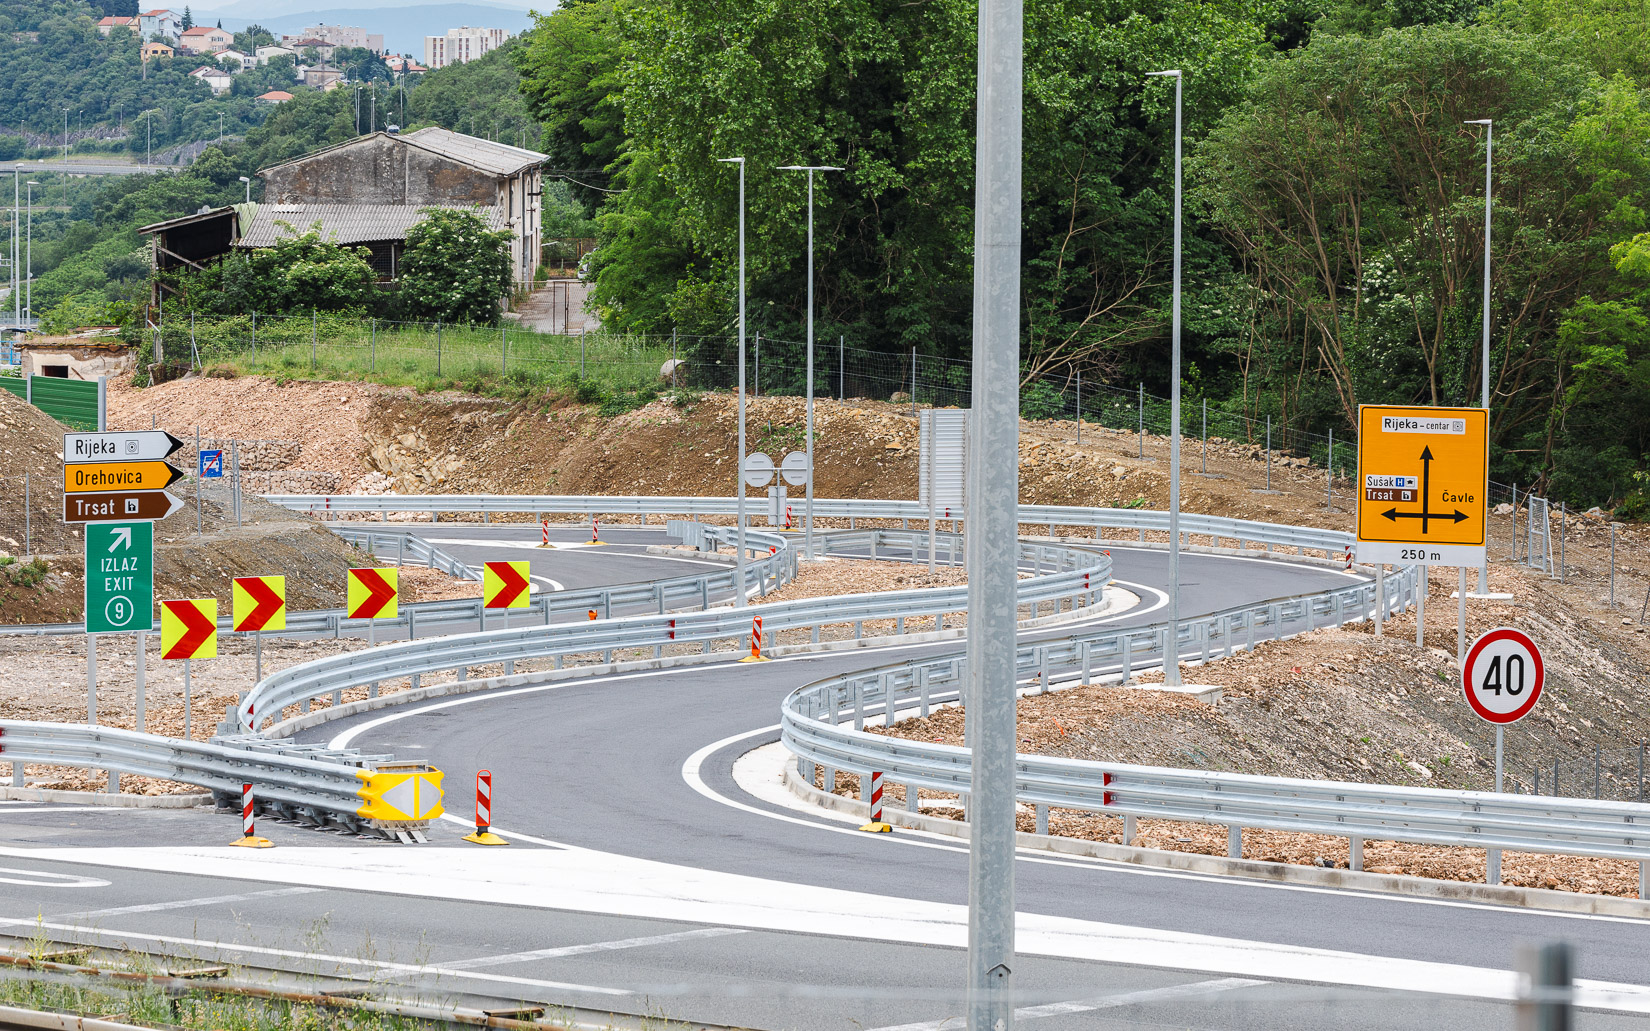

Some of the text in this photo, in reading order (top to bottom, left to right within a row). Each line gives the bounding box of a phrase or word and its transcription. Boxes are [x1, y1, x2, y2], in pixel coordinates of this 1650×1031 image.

[1384, 418, 1418, 431] Rijeka
[1426, 421, 1450, 430] centar
[75, 438, 116, 458] Rijeka
[75, 469, 142, 486] Orehovica
[1367, 475, 1394, 487] Sušak
[1366, 488, 1393, 500] Trsat
[1442, 489, 1475, 503] Čavle
[75, 499, 115, 516] Trsat
[1401, 549, 1441, 561] 250 m
[101, 557, 138, 573] IZLAZ
[104, 576, 134, 592] EXIT
[115, 602, 124, 620] 9
[1482, 653, 1525, 696] 40
